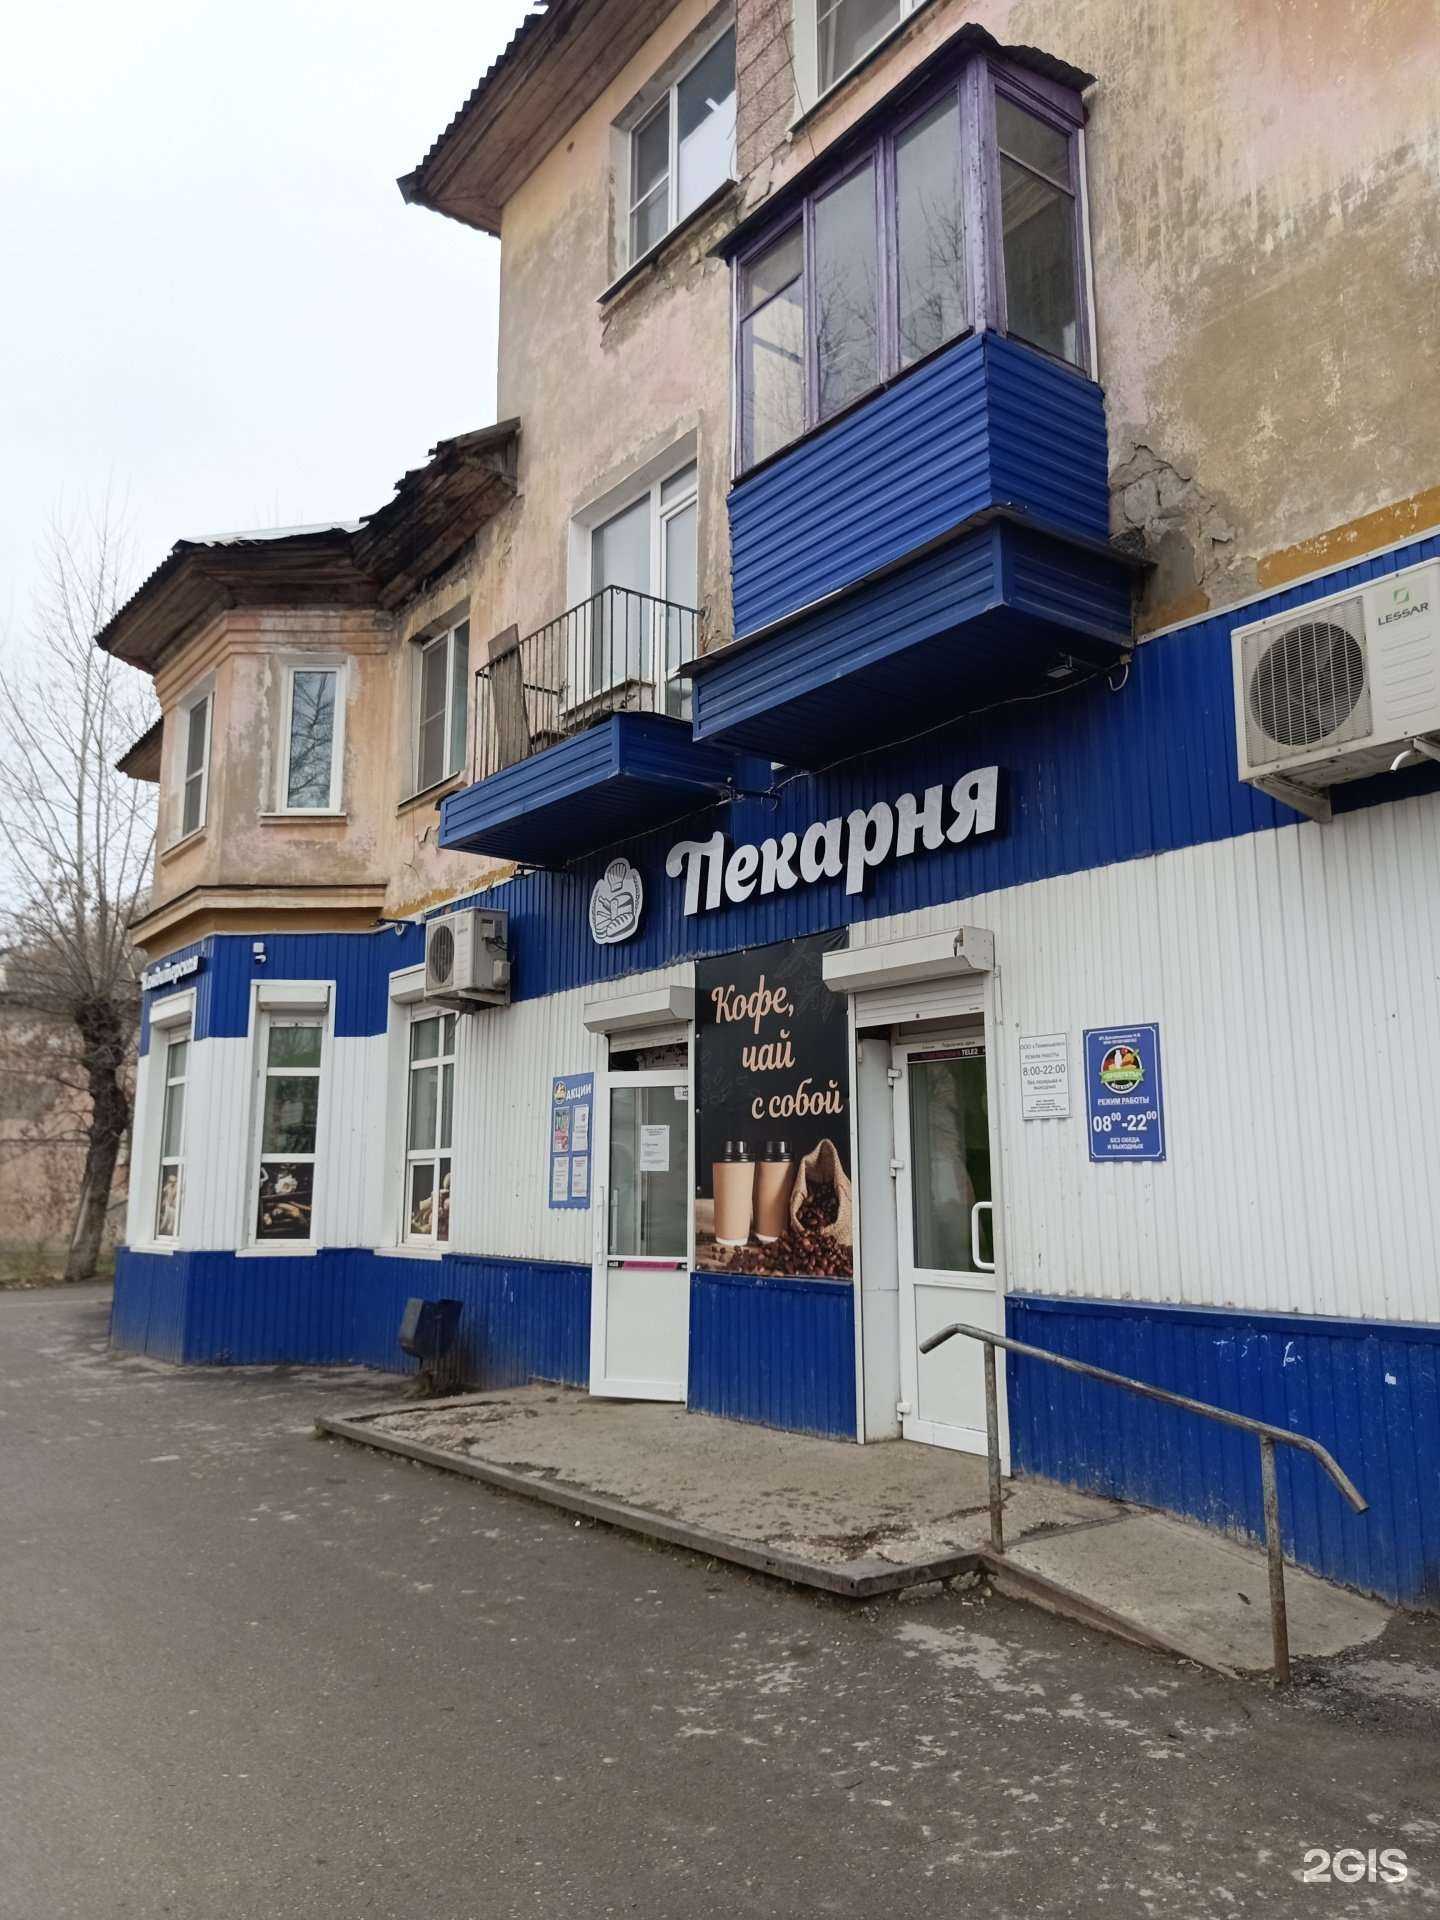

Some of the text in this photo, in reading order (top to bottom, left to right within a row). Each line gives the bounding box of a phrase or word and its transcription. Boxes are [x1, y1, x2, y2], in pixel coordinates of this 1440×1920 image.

[1377, 602, 1429, 626] LESSAR
[665, 765, 998, 917] Пекарня
[711, 974, 794, 1035] Кофе,
[742, 1028, 796, 1072] чай
[566, 1083, 592, 1101] АКЦИИ
[751, 1077, 844, 1120] с собой
[1097, 1096, 1150, 1106] РЕЖИМ РАБОТЫ
